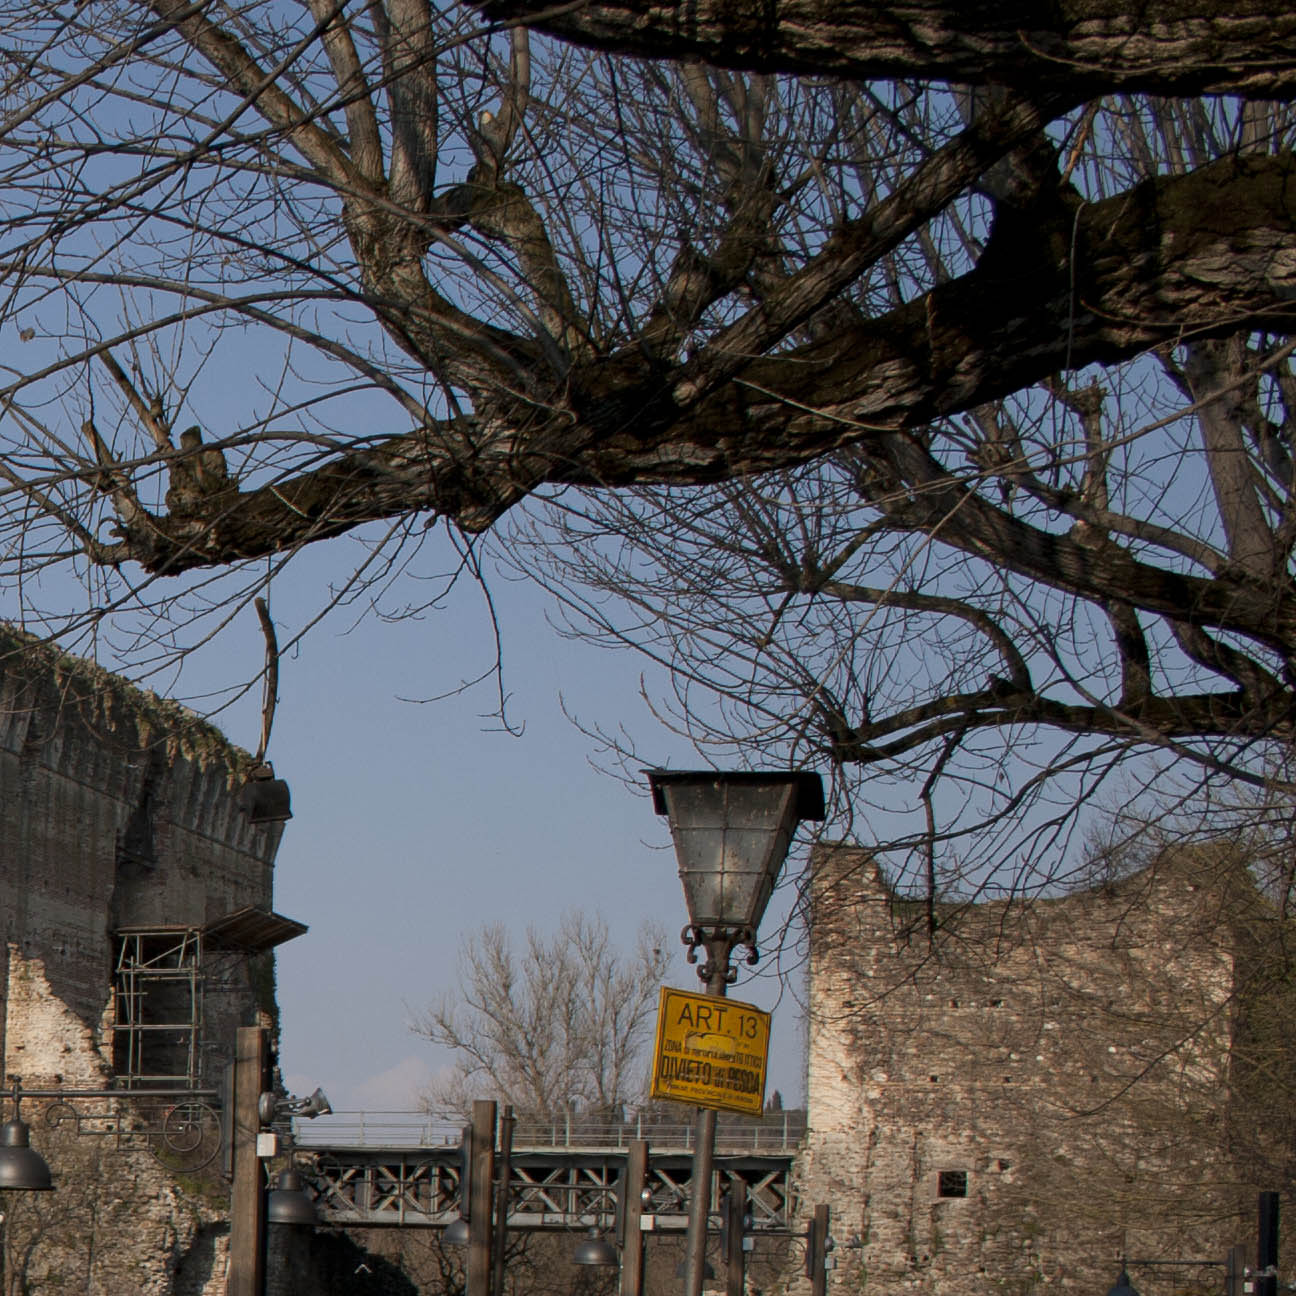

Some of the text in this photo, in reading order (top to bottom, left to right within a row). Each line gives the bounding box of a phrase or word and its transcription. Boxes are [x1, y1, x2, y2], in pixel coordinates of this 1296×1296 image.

[678, 1003, 758, 1039] ART. 13
[661, 1056, 712, 1086] DIVIETO
